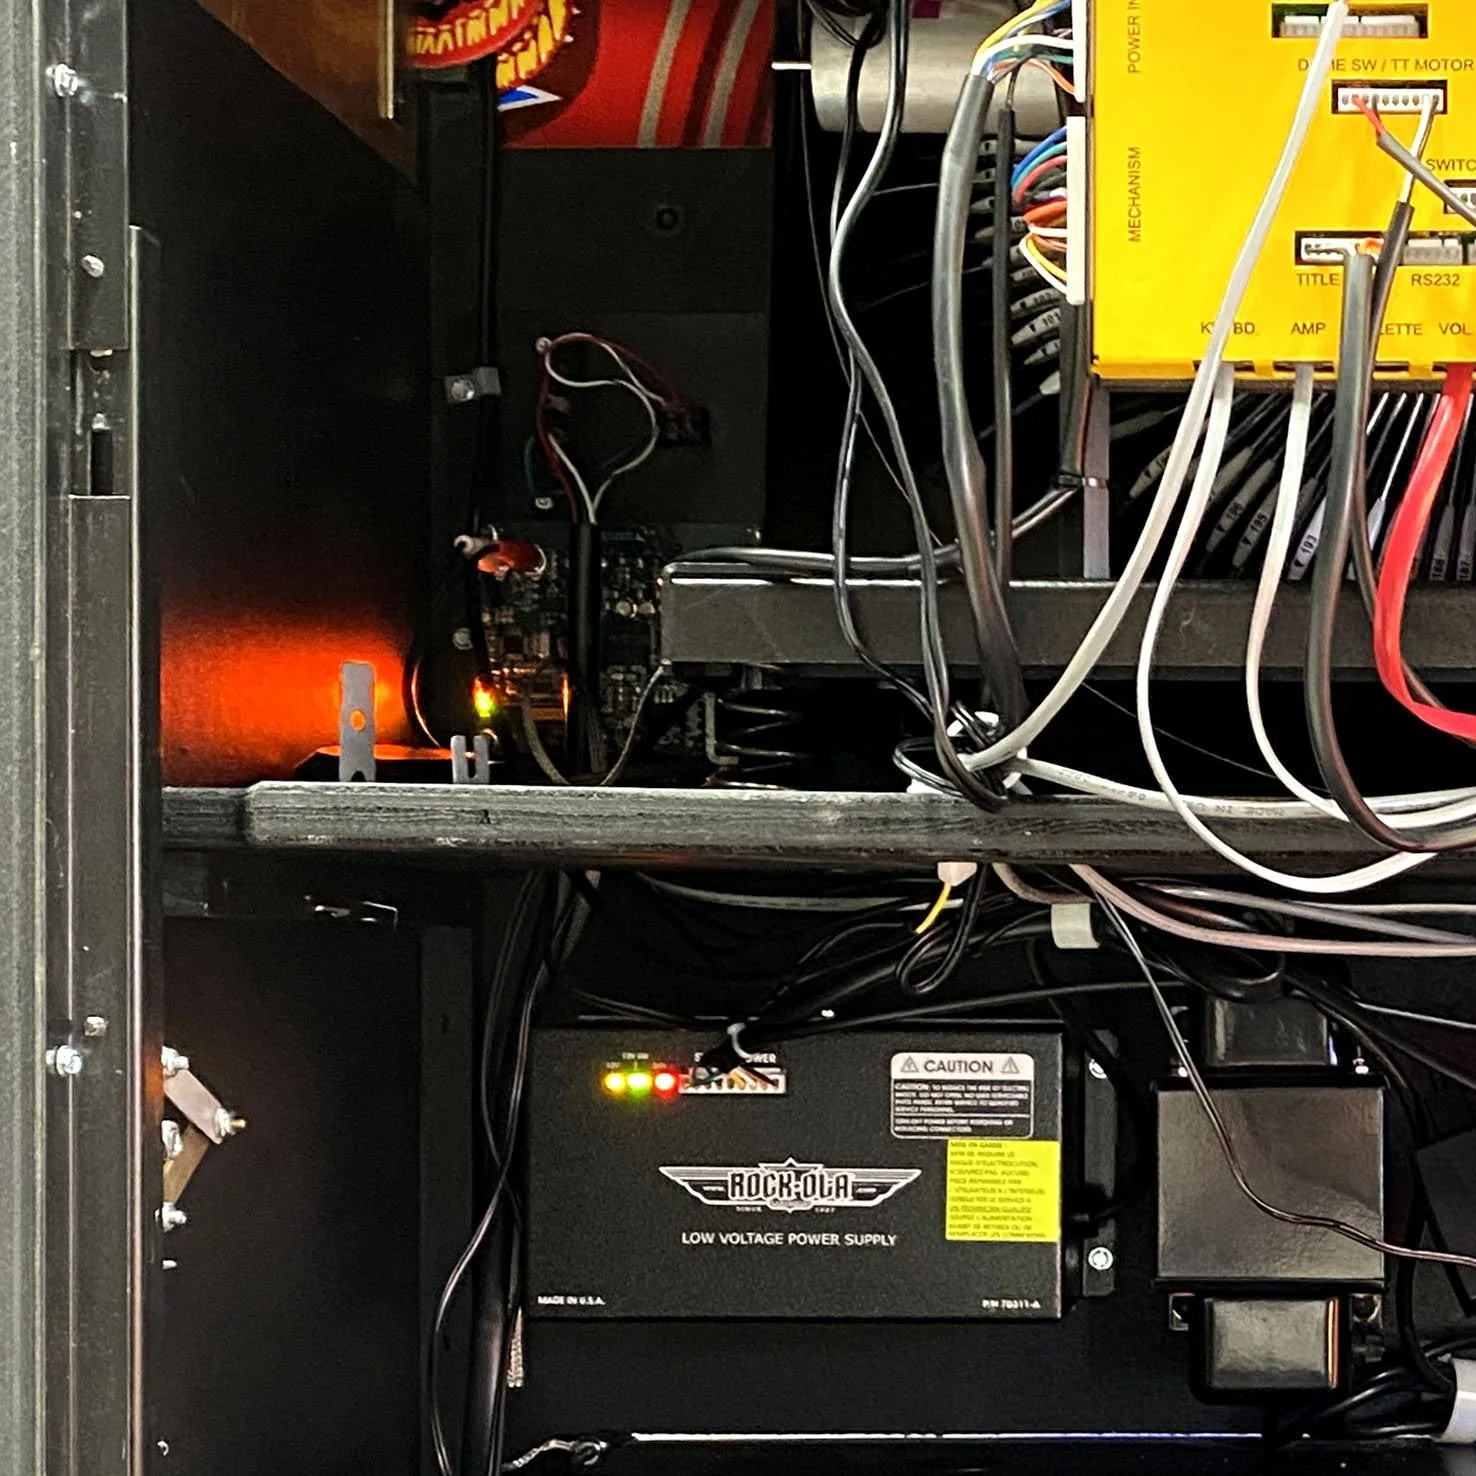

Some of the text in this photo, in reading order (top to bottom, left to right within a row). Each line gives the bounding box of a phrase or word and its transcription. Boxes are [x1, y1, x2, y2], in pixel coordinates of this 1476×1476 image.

[1127, 15, 1142, 73] POWER
[1297, 58, 1474, 72] DE SW TT MOTOR
[1127, 146, 1141, 242] MECHANISM
[1296, 273, 1340, 287] TITLE
[1411, 273, 1460, 287] RS232
[1200, 322, 1256, 335] KBD
[1290, 322, 1327, 335] AMP
[1438, 322, 1473, 336] VOL
[923, 1060, 994, 1073] CAUTION
[727, 1169, 856, 1202] ROCK-OLA
[681, 1232, 898, 1246] LOW VOLTAGE POWER SUPPLY
